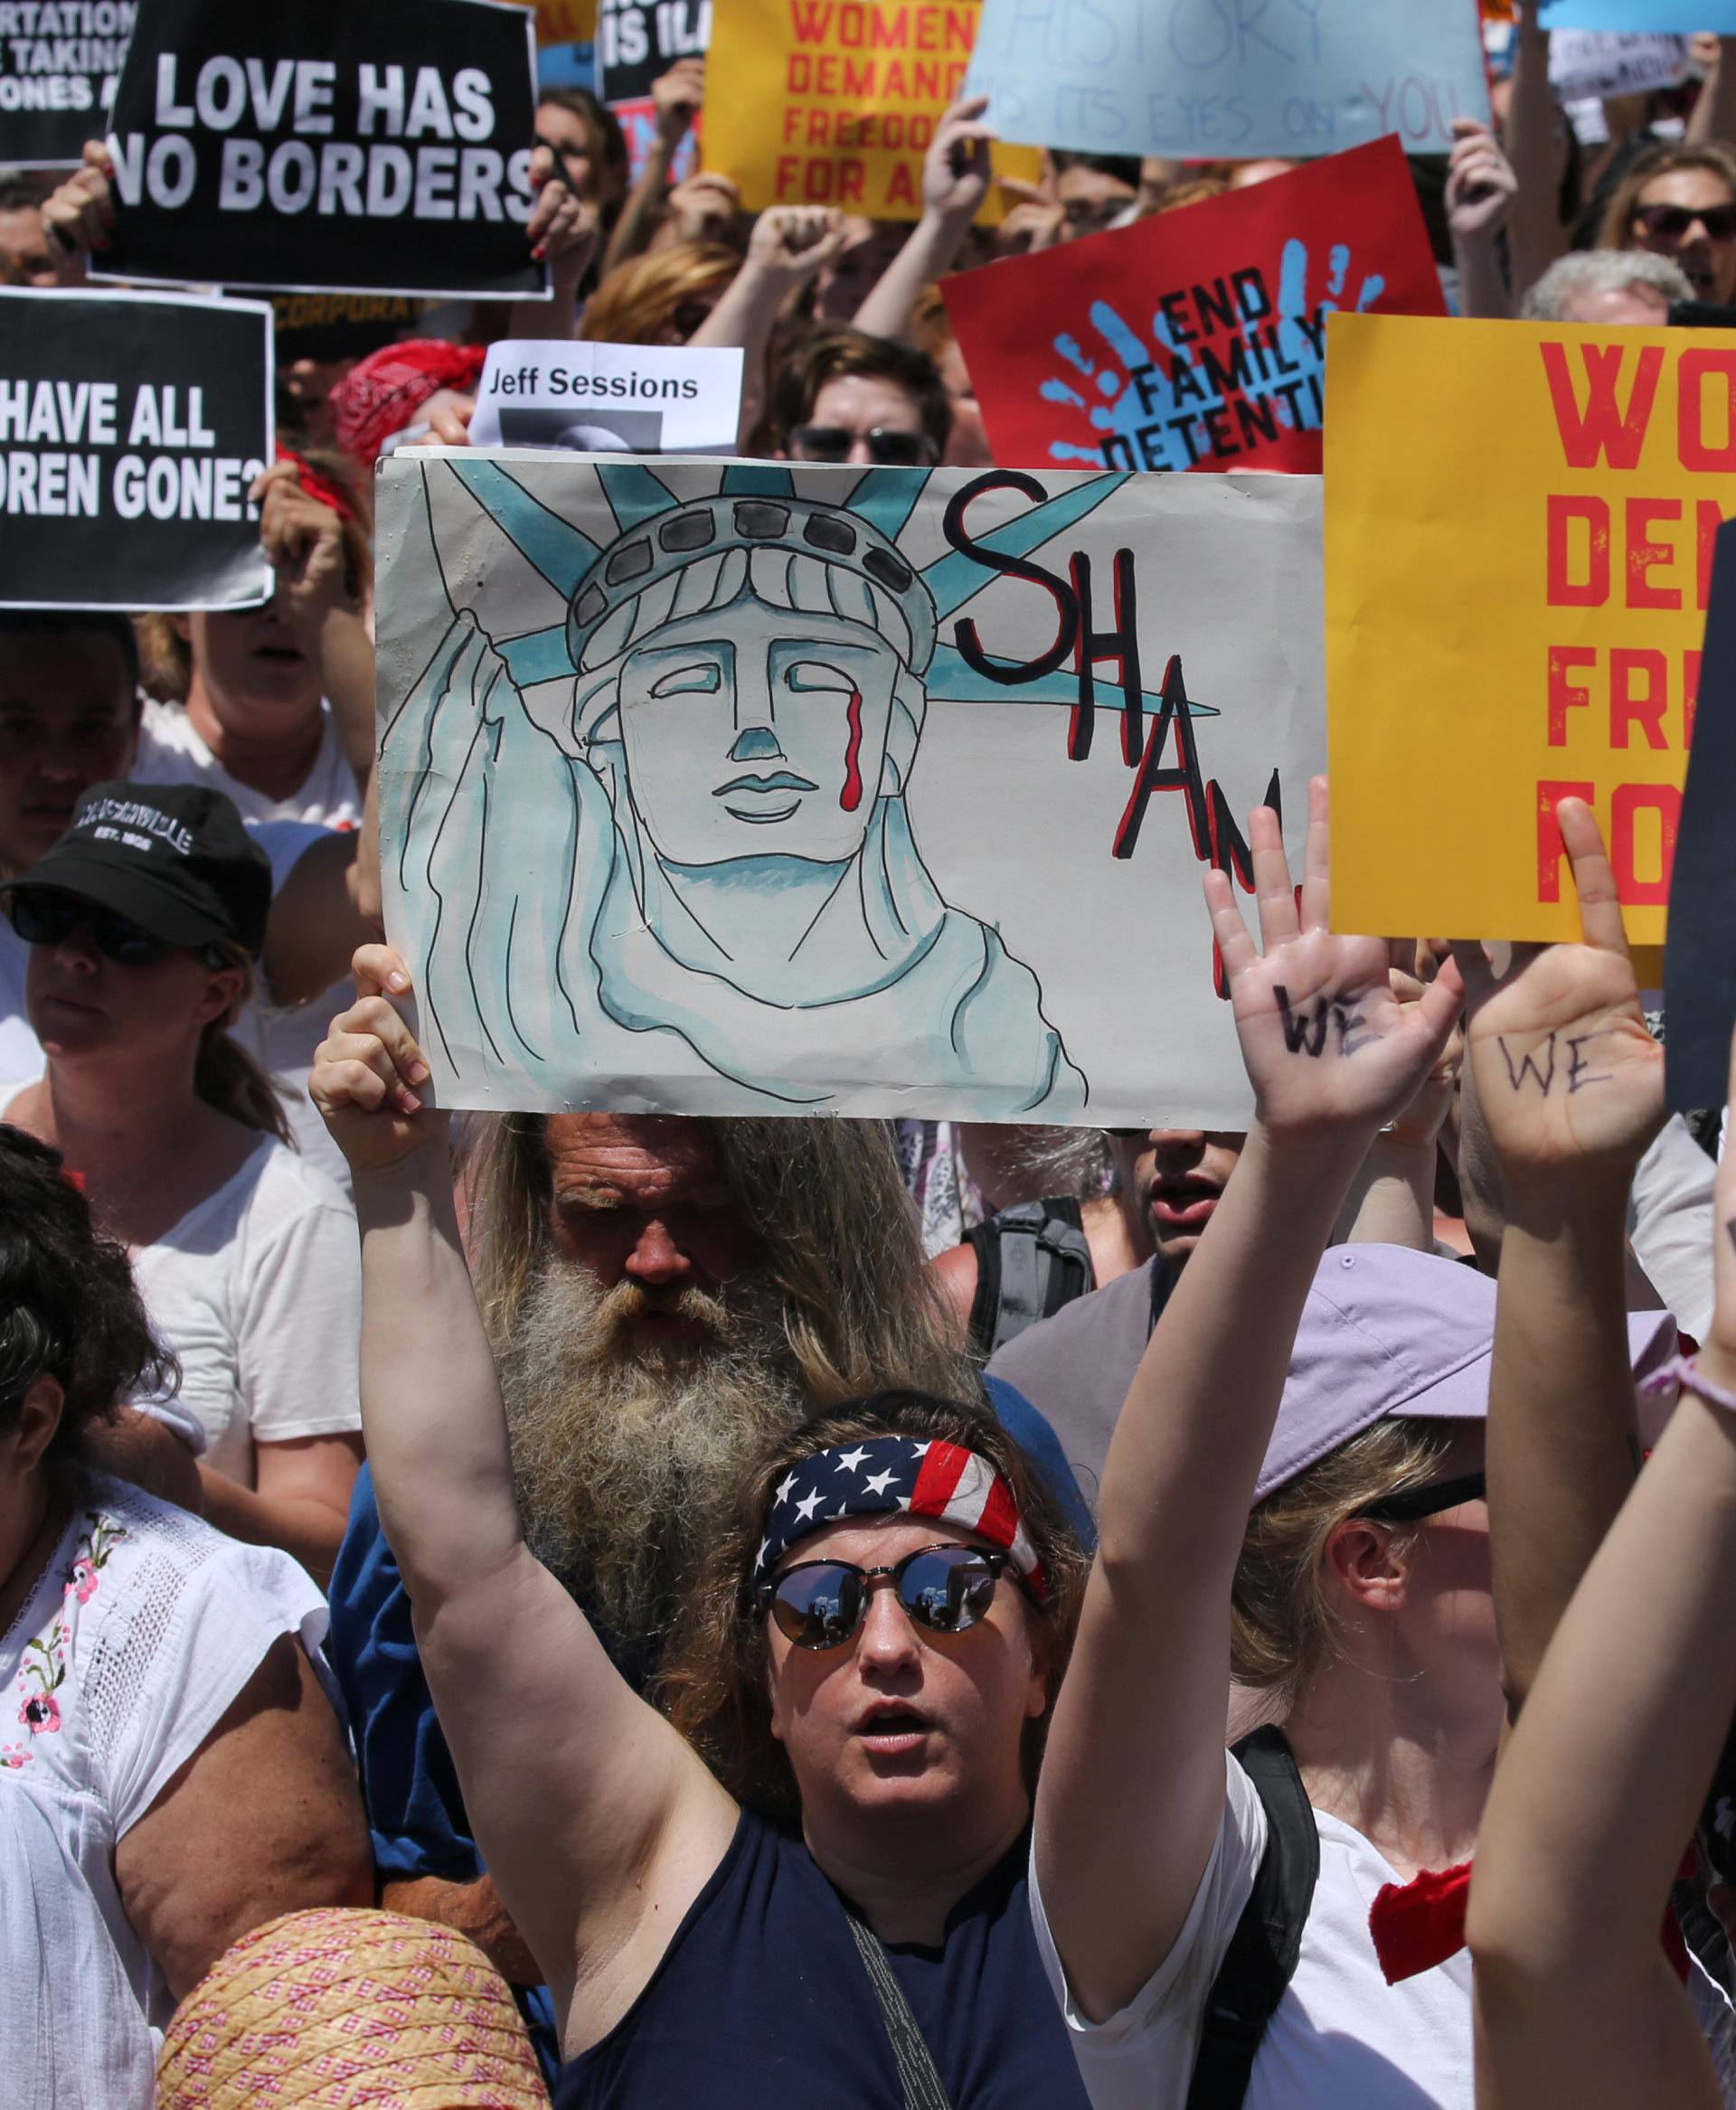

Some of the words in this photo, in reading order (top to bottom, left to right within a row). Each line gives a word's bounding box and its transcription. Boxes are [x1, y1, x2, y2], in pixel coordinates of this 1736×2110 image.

[602, 7, 649, 67] IS
[790, 0, 975, 52] WOMEN
[155, 53, 336, 134] LOVE
[357, 63, 495, 141] HAS
[1052, 85, 1128, 138] ITS
[1148, 92, 1254, 145] EYES
[1281, 96, 1336, 138] ON
[1359, 77, 1461, 143] YOU
[106, 133, 197, 209] NO
[219, 138, 536, 223] BORDERS
[776, 154, 865, 204] FOR
[1159, 268, 1272, 344] END
[489, 367, 540, 395] Jeff
[548, 369, 699, 400] Sessions
[1130, 307, 1326, 417] FAMILY
[0, 380, 118, 444] HAVE
[128, 384, 216, 448] ALL
[113, 455, 264, 522] GONE?
[1273, 984, 1385, 1059] WE
[1496, 1031, 1613, 1098] WE
